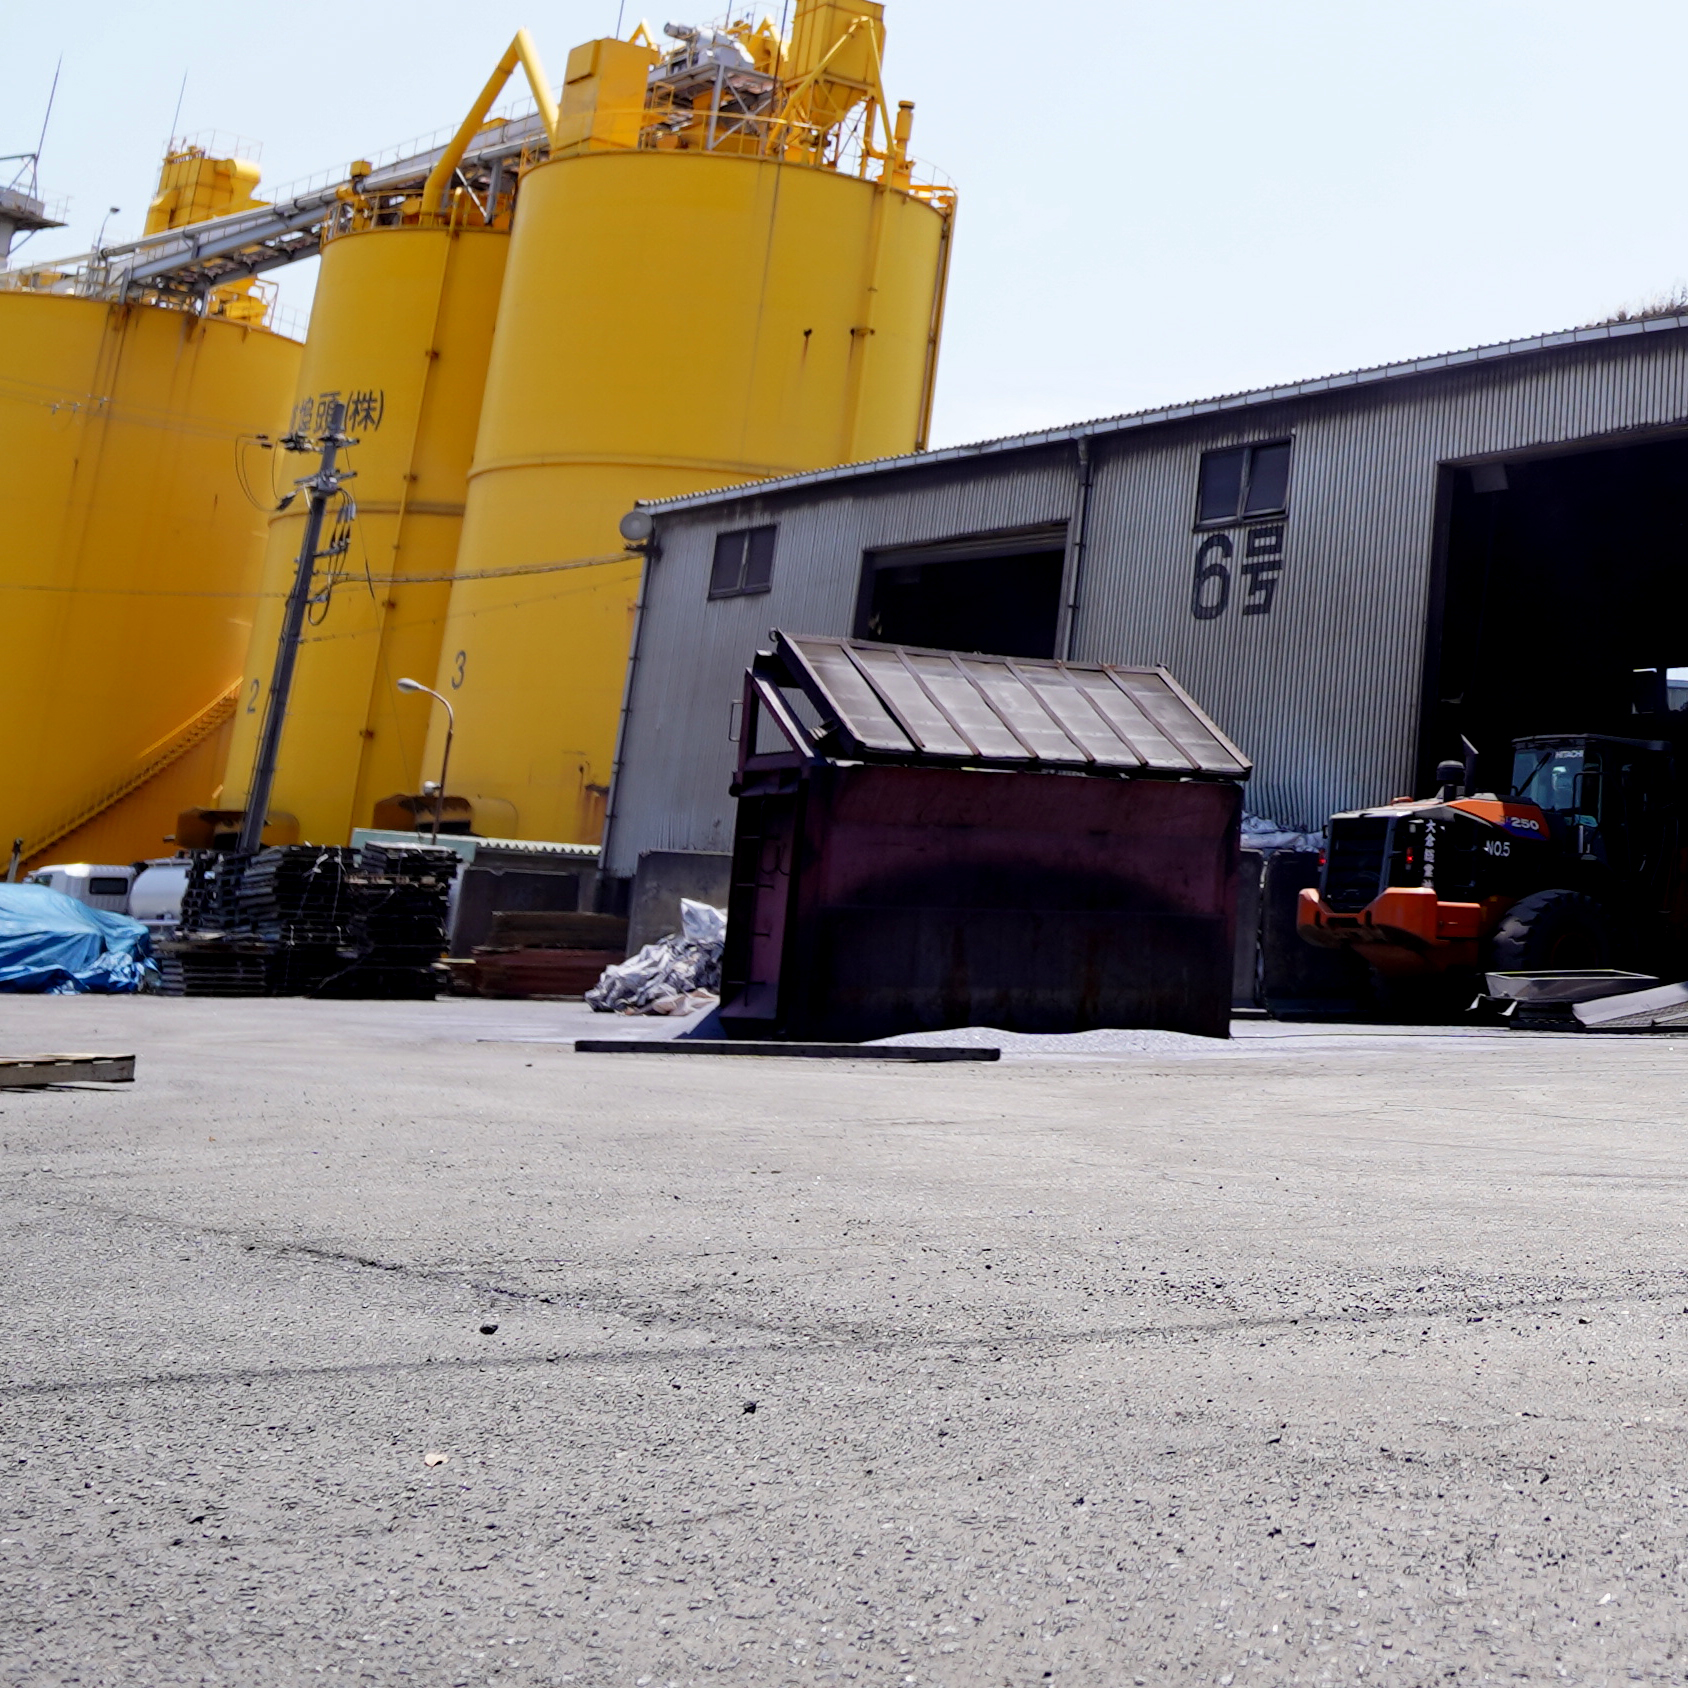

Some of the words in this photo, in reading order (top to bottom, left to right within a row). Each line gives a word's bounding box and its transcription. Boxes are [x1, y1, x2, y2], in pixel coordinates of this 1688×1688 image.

[1191, 525, 1284, 619] 6号
[451, 650, 467, 690] 3
[246, 678, 260, 713] 2
